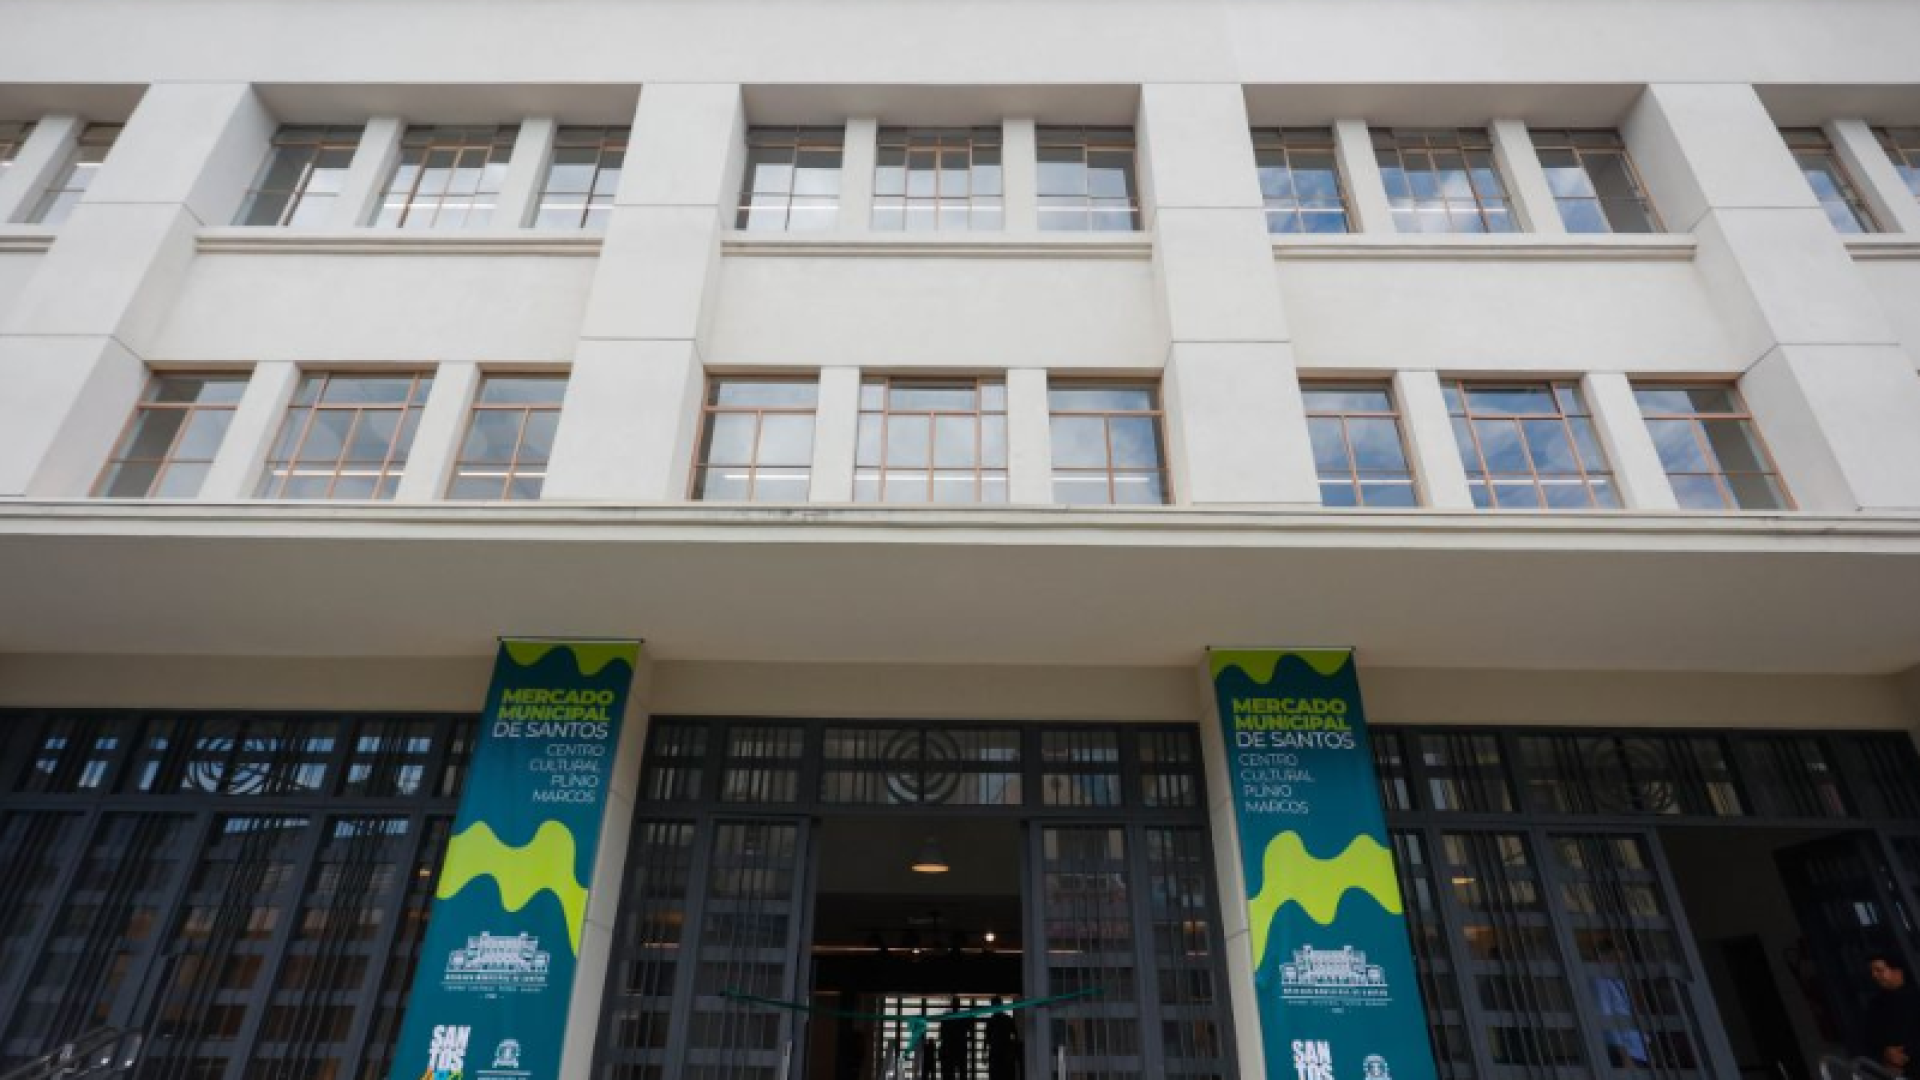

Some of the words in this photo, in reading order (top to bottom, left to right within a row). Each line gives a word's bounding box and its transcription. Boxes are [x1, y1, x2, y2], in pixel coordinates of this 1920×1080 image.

[502, 688, 614, 704] MERCADO
[497, 705, 610, 721] MUNICIPAL
[1232, 697, 1347, 714] MERCADO
[492, 722, 521, 738] DE
[525, 722, 608, 739] SANTOS
[1234, 714, 1351, 731] MUNICIPAL
[1236, 731, 1267, 748] DE
[1271, 731, 1356, 750] SANTOS
[546, 743, 605, 757] CENTRO
[530, 758, 599, 773] CULTURAL
[1238, 753, 1298, 766] CENTRO
[1240, 768, 1315, 783] CULTURAL
[532, 789, 595, 803] MARCOS
[1245, 800, 1309, 814] MARCOS
[431, 1025, 471, 1047] SAN
[1291, 1039, 1331, 1062] SAN
